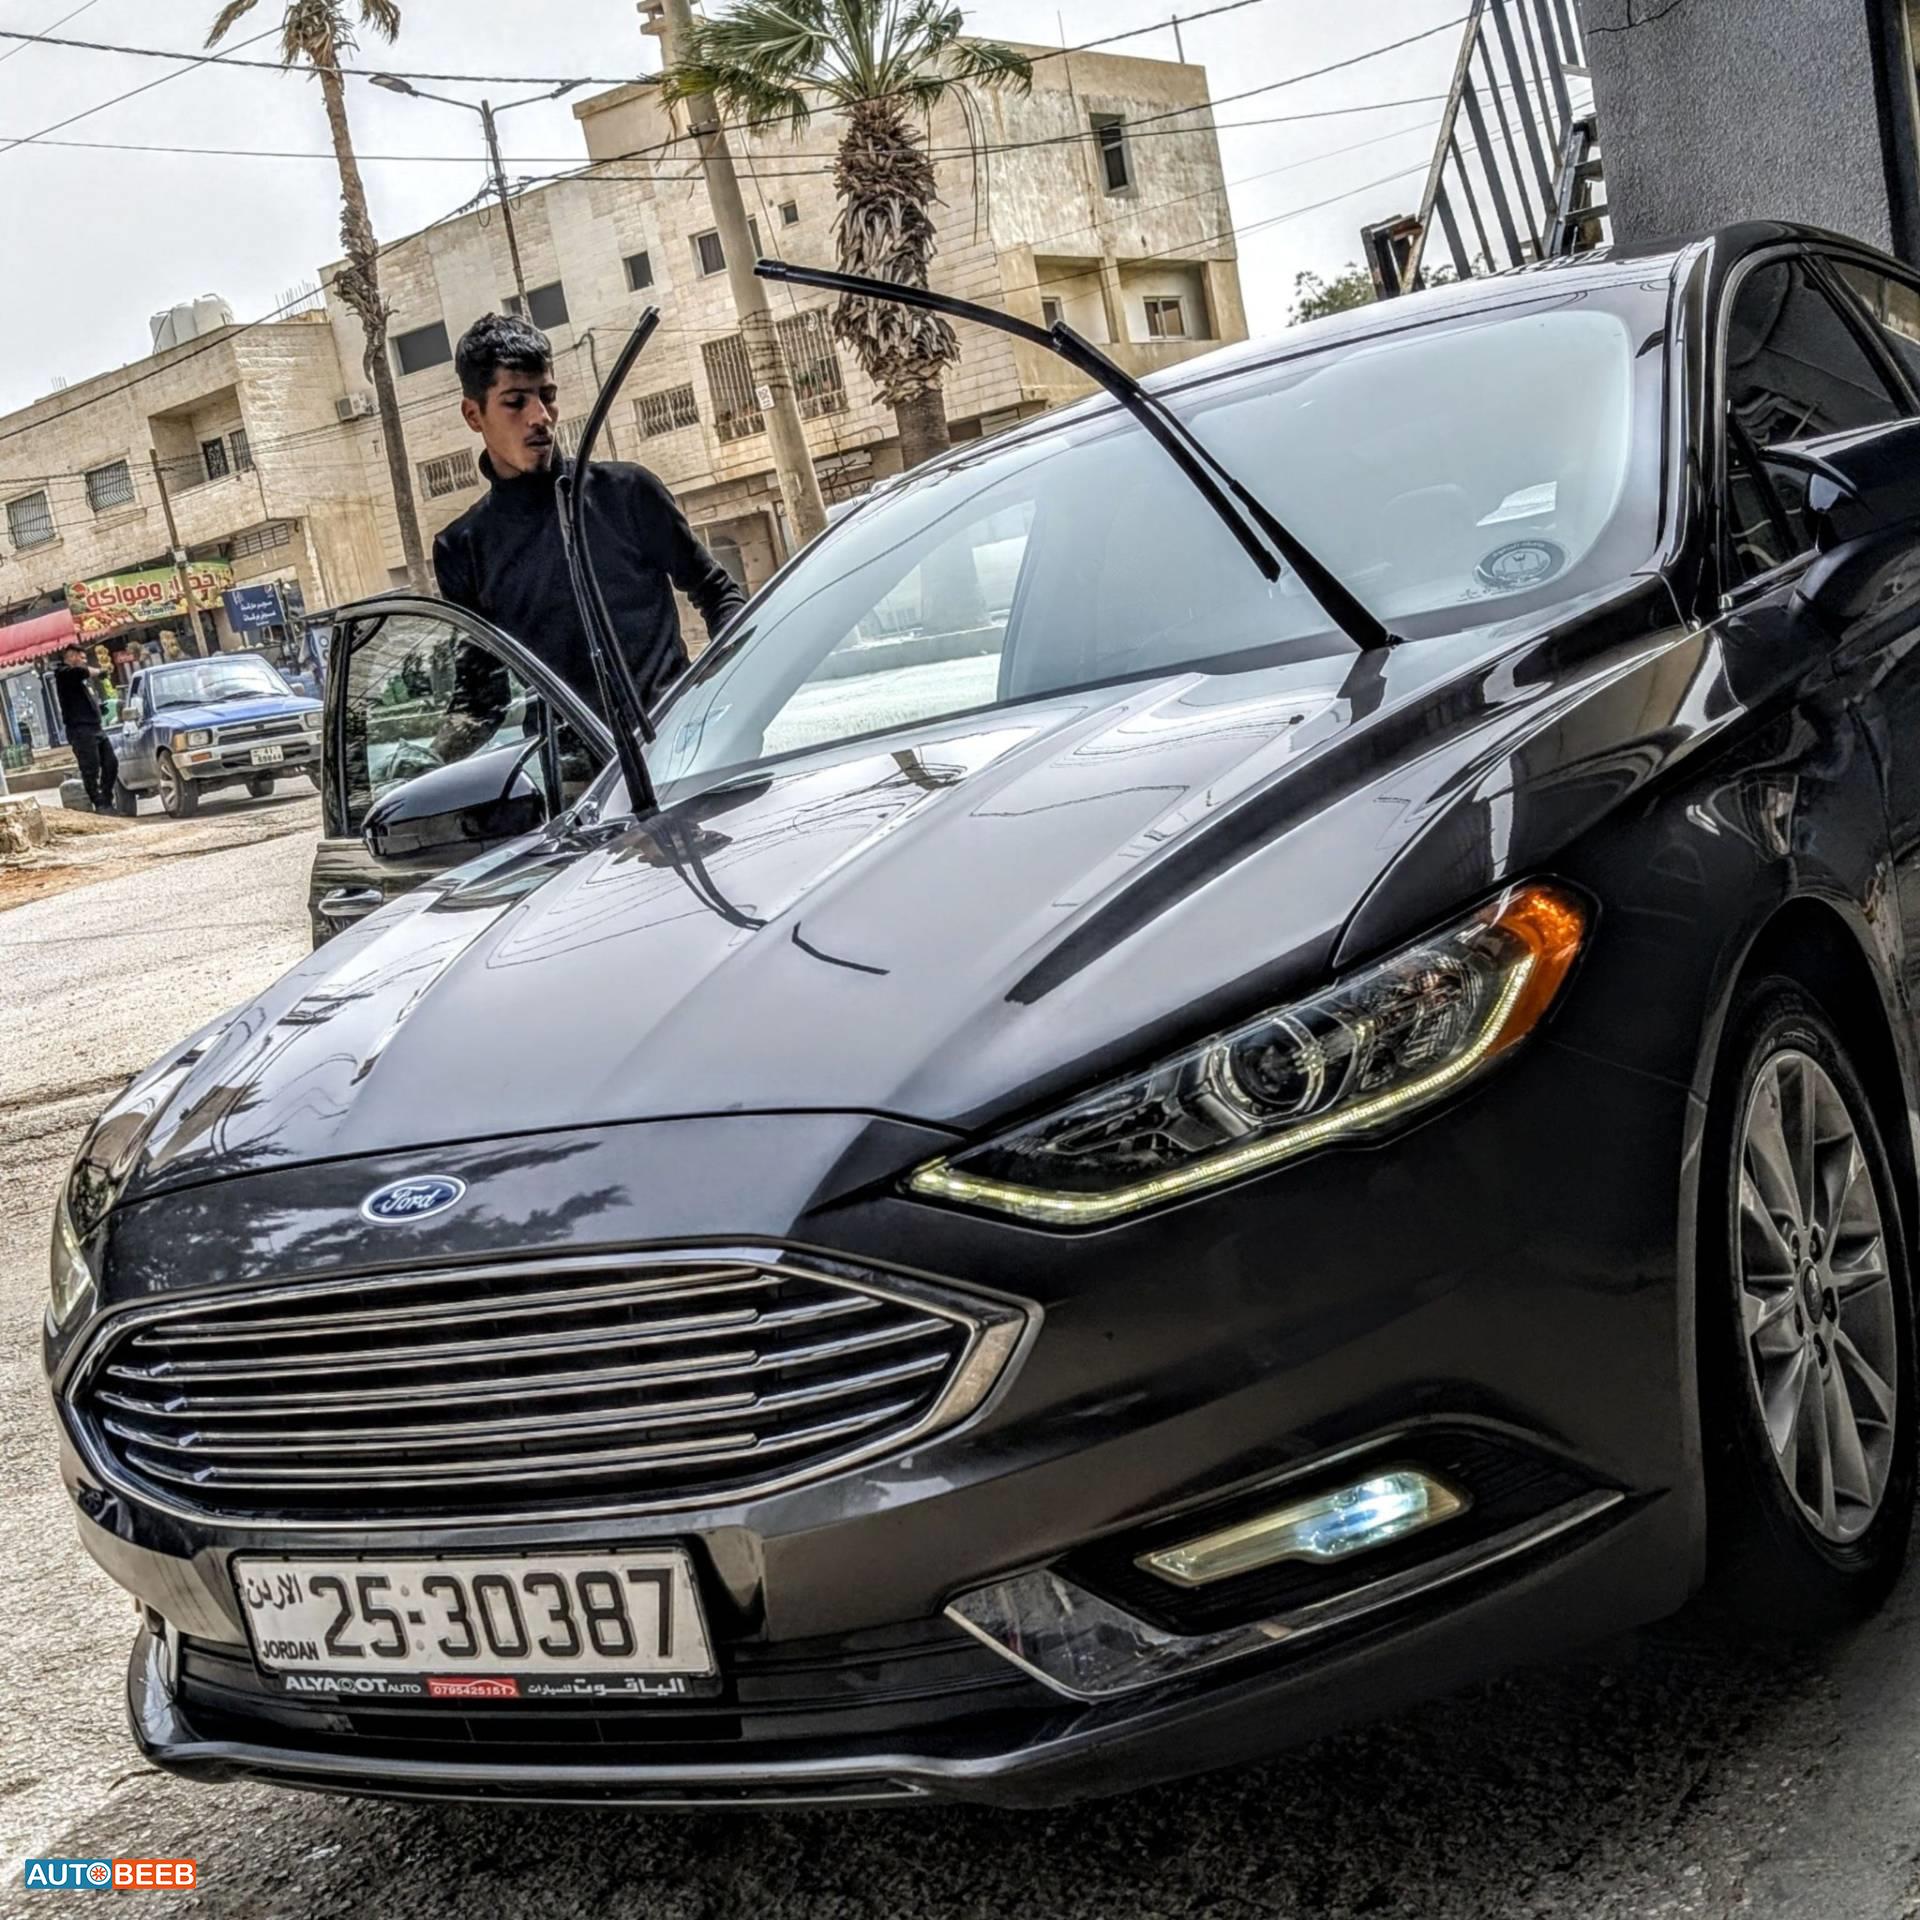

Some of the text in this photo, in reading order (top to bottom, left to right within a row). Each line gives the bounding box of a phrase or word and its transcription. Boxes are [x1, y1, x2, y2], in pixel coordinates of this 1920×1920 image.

[381, 1184, 442, 1213] Ford
[262, 1640, 320, 1661] JORDAN
[285, 1676, 422, 1694] ALYAQOT AUTO
